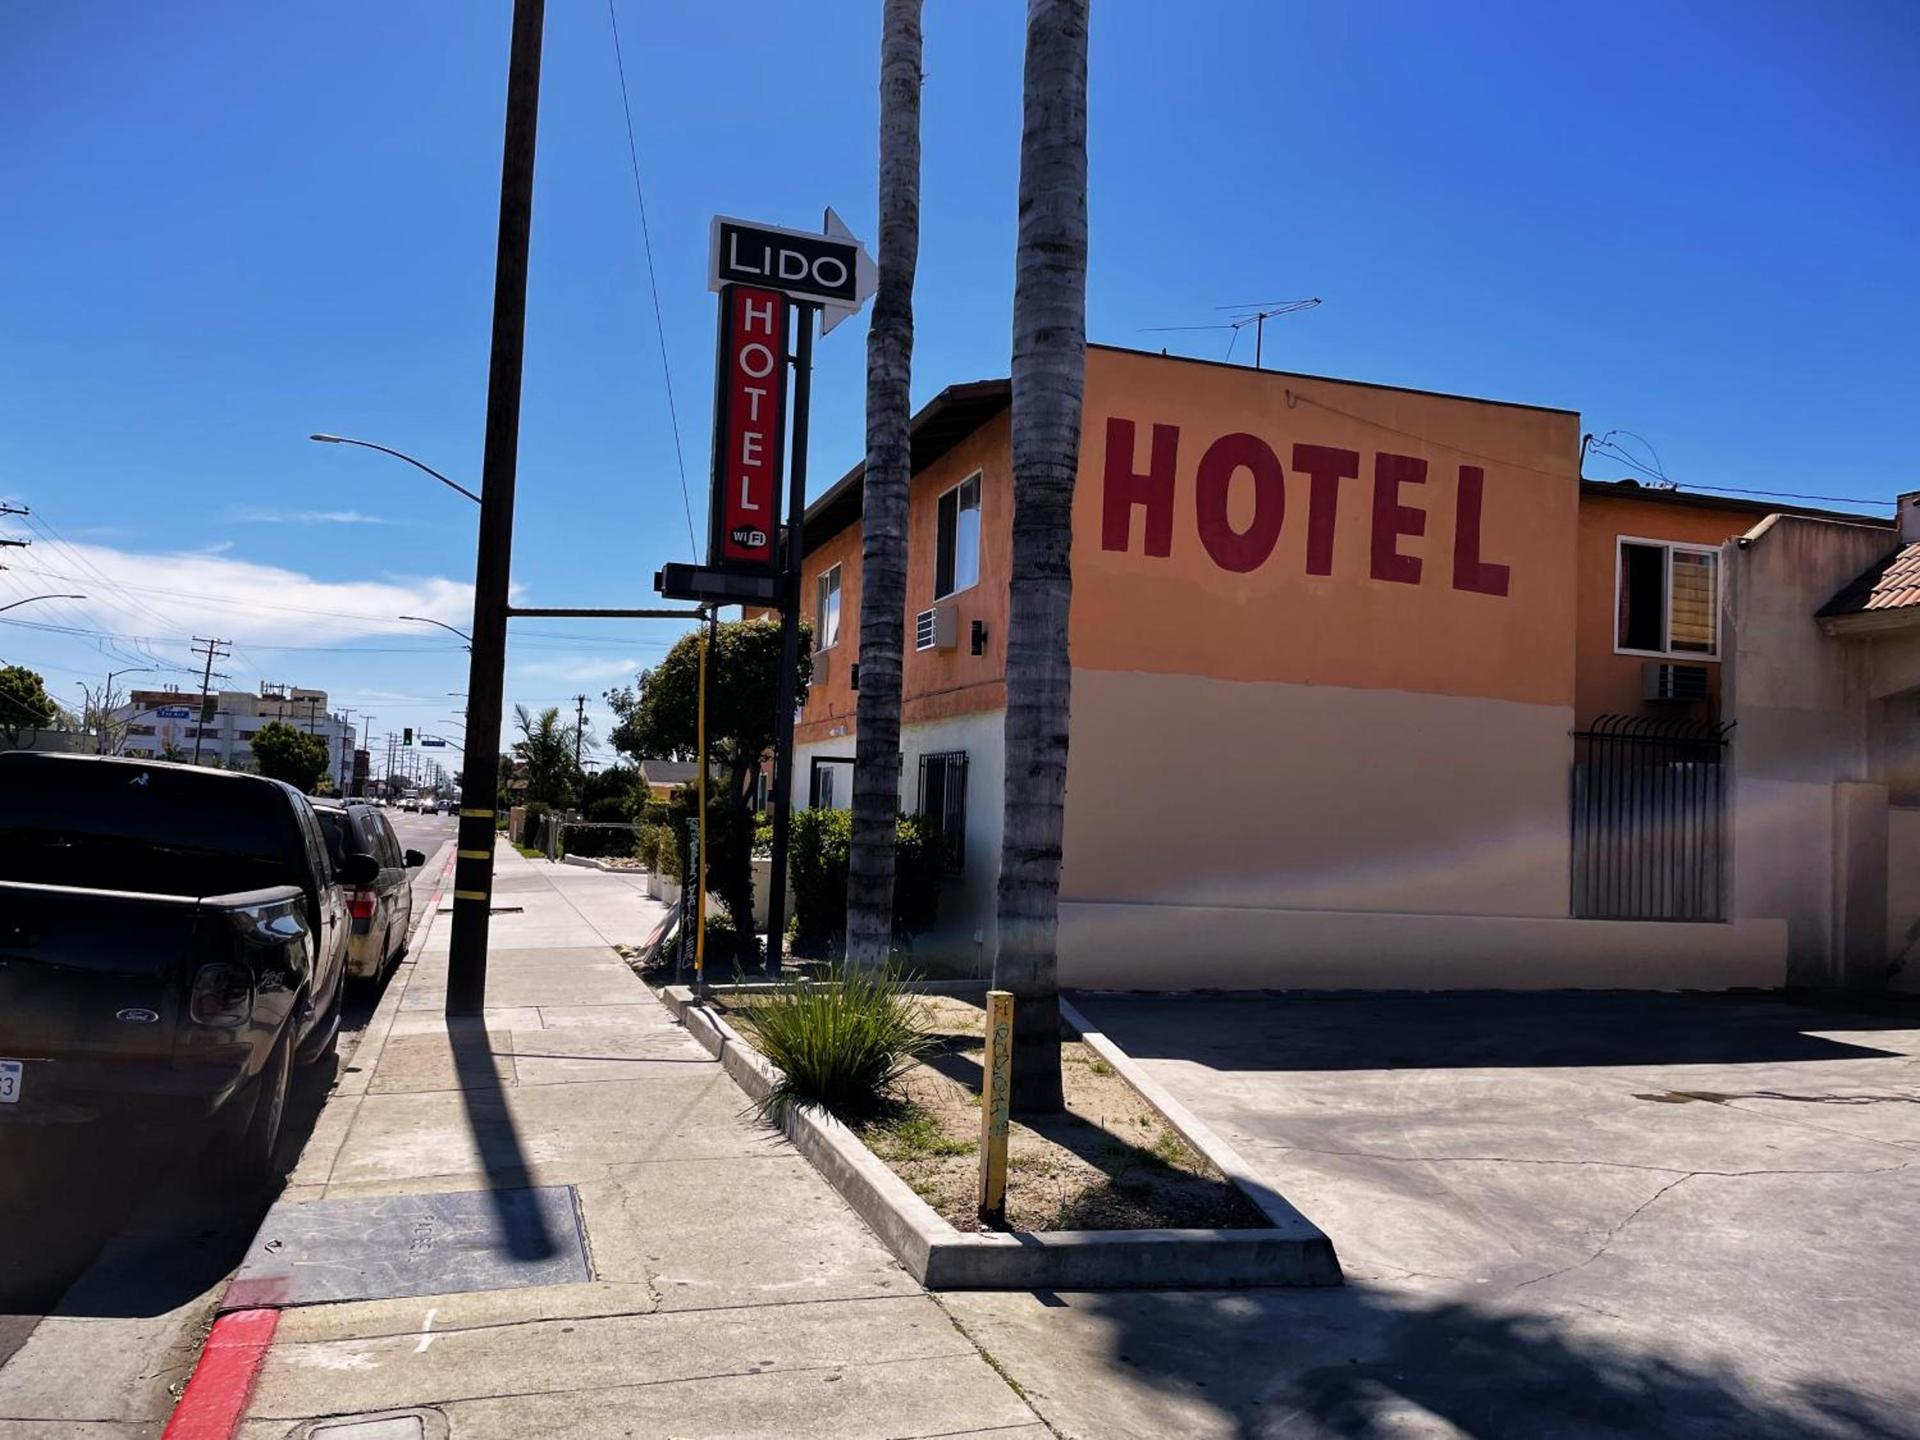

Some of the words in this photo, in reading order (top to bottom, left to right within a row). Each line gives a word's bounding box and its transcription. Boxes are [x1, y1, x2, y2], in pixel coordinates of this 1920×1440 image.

[730, 232, 847, 287] LIDO
[739, 298, 773, 511] HOTEL
[1101, 416, 1510, 597] HOTEL
